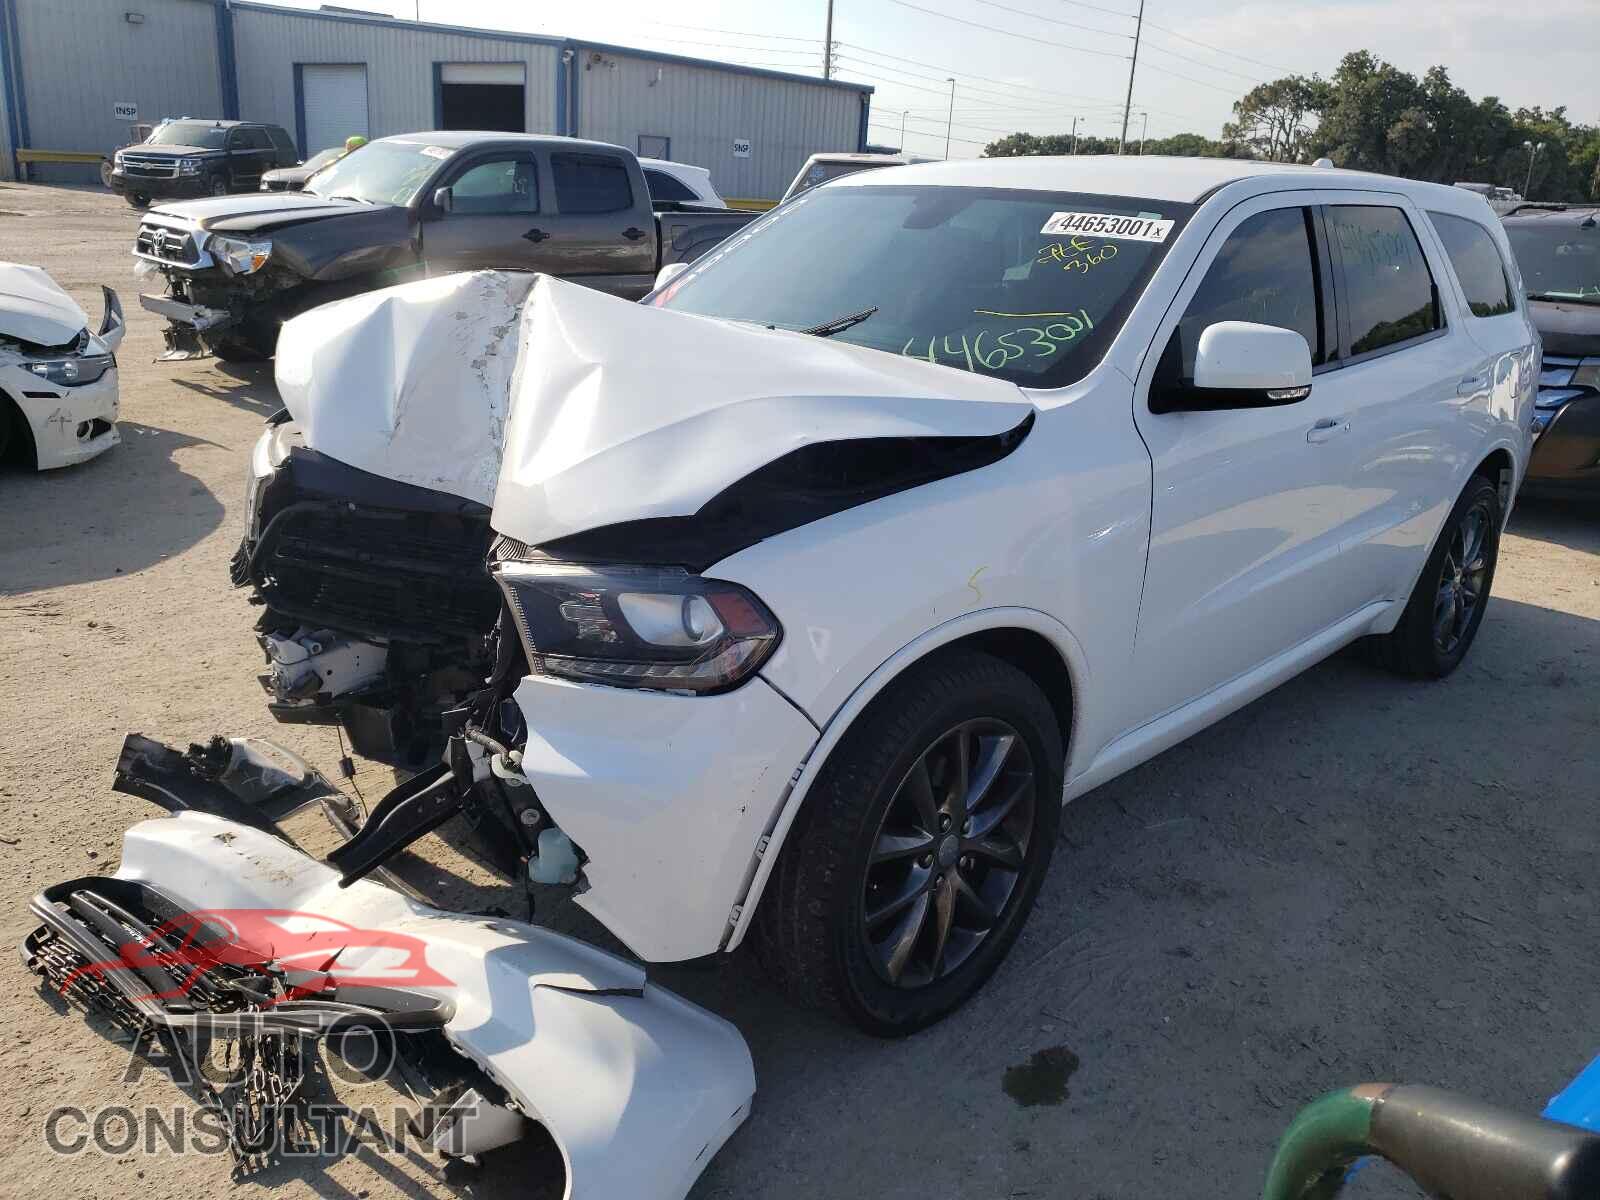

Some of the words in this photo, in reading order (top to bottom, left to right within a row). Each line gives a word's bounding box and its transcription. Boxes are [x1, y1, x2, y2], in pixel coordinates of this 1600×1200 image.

[115, 106, 137, 116] INSP
[1060, 214, 1154, 237] 44653001
[1063, 245, 1118, 274] 360
